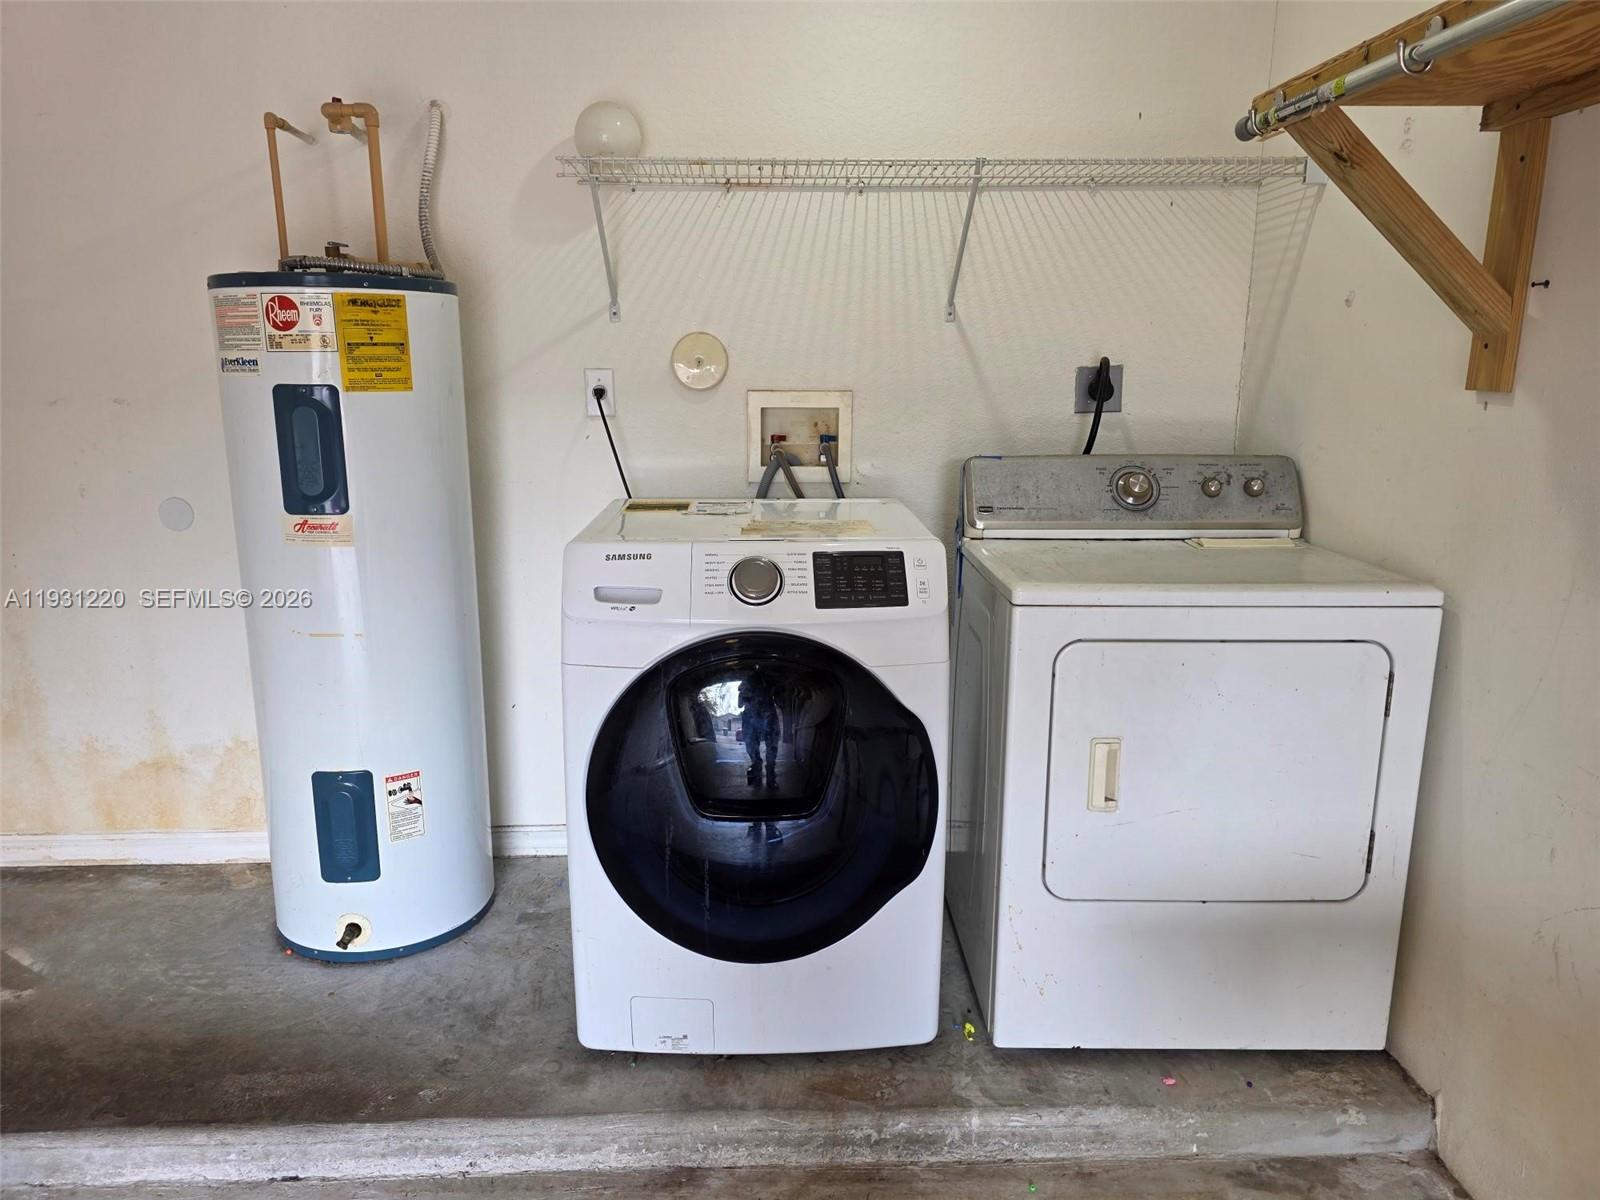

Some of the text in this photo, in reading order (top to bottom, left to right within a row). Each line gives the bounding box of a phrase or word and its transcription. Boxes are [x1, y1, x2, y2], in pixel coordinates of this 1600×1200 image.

[267, 296, 299, 327] Rheem
[224, 357, 259, 367] EverKleen
[604, 553, 652, 562] SAMSUNG
